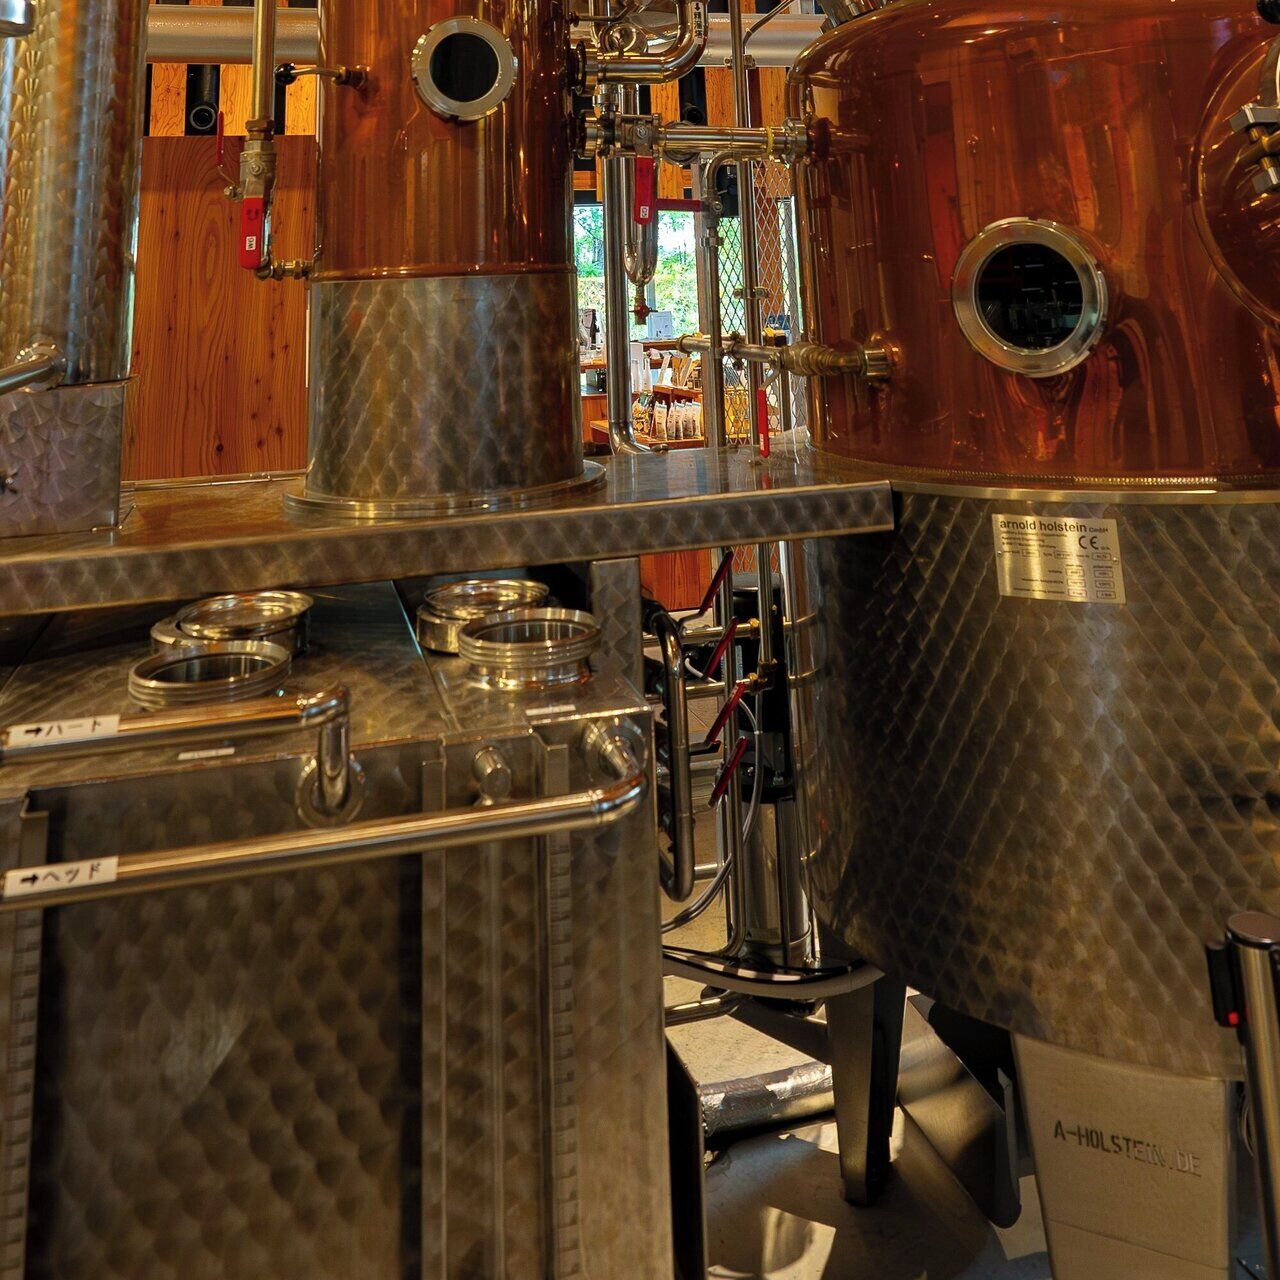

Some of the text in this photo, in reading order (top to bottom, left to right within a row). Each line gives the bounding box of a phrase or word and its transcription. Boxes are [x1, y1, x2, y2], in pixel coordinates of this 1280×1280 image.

[1000, 519, 1036, 530] arnold
[1039, 520, 1087, 532] holstein
[45, 720, 101, 738] ハート
[43, 861, 101, 884] ヘッド
